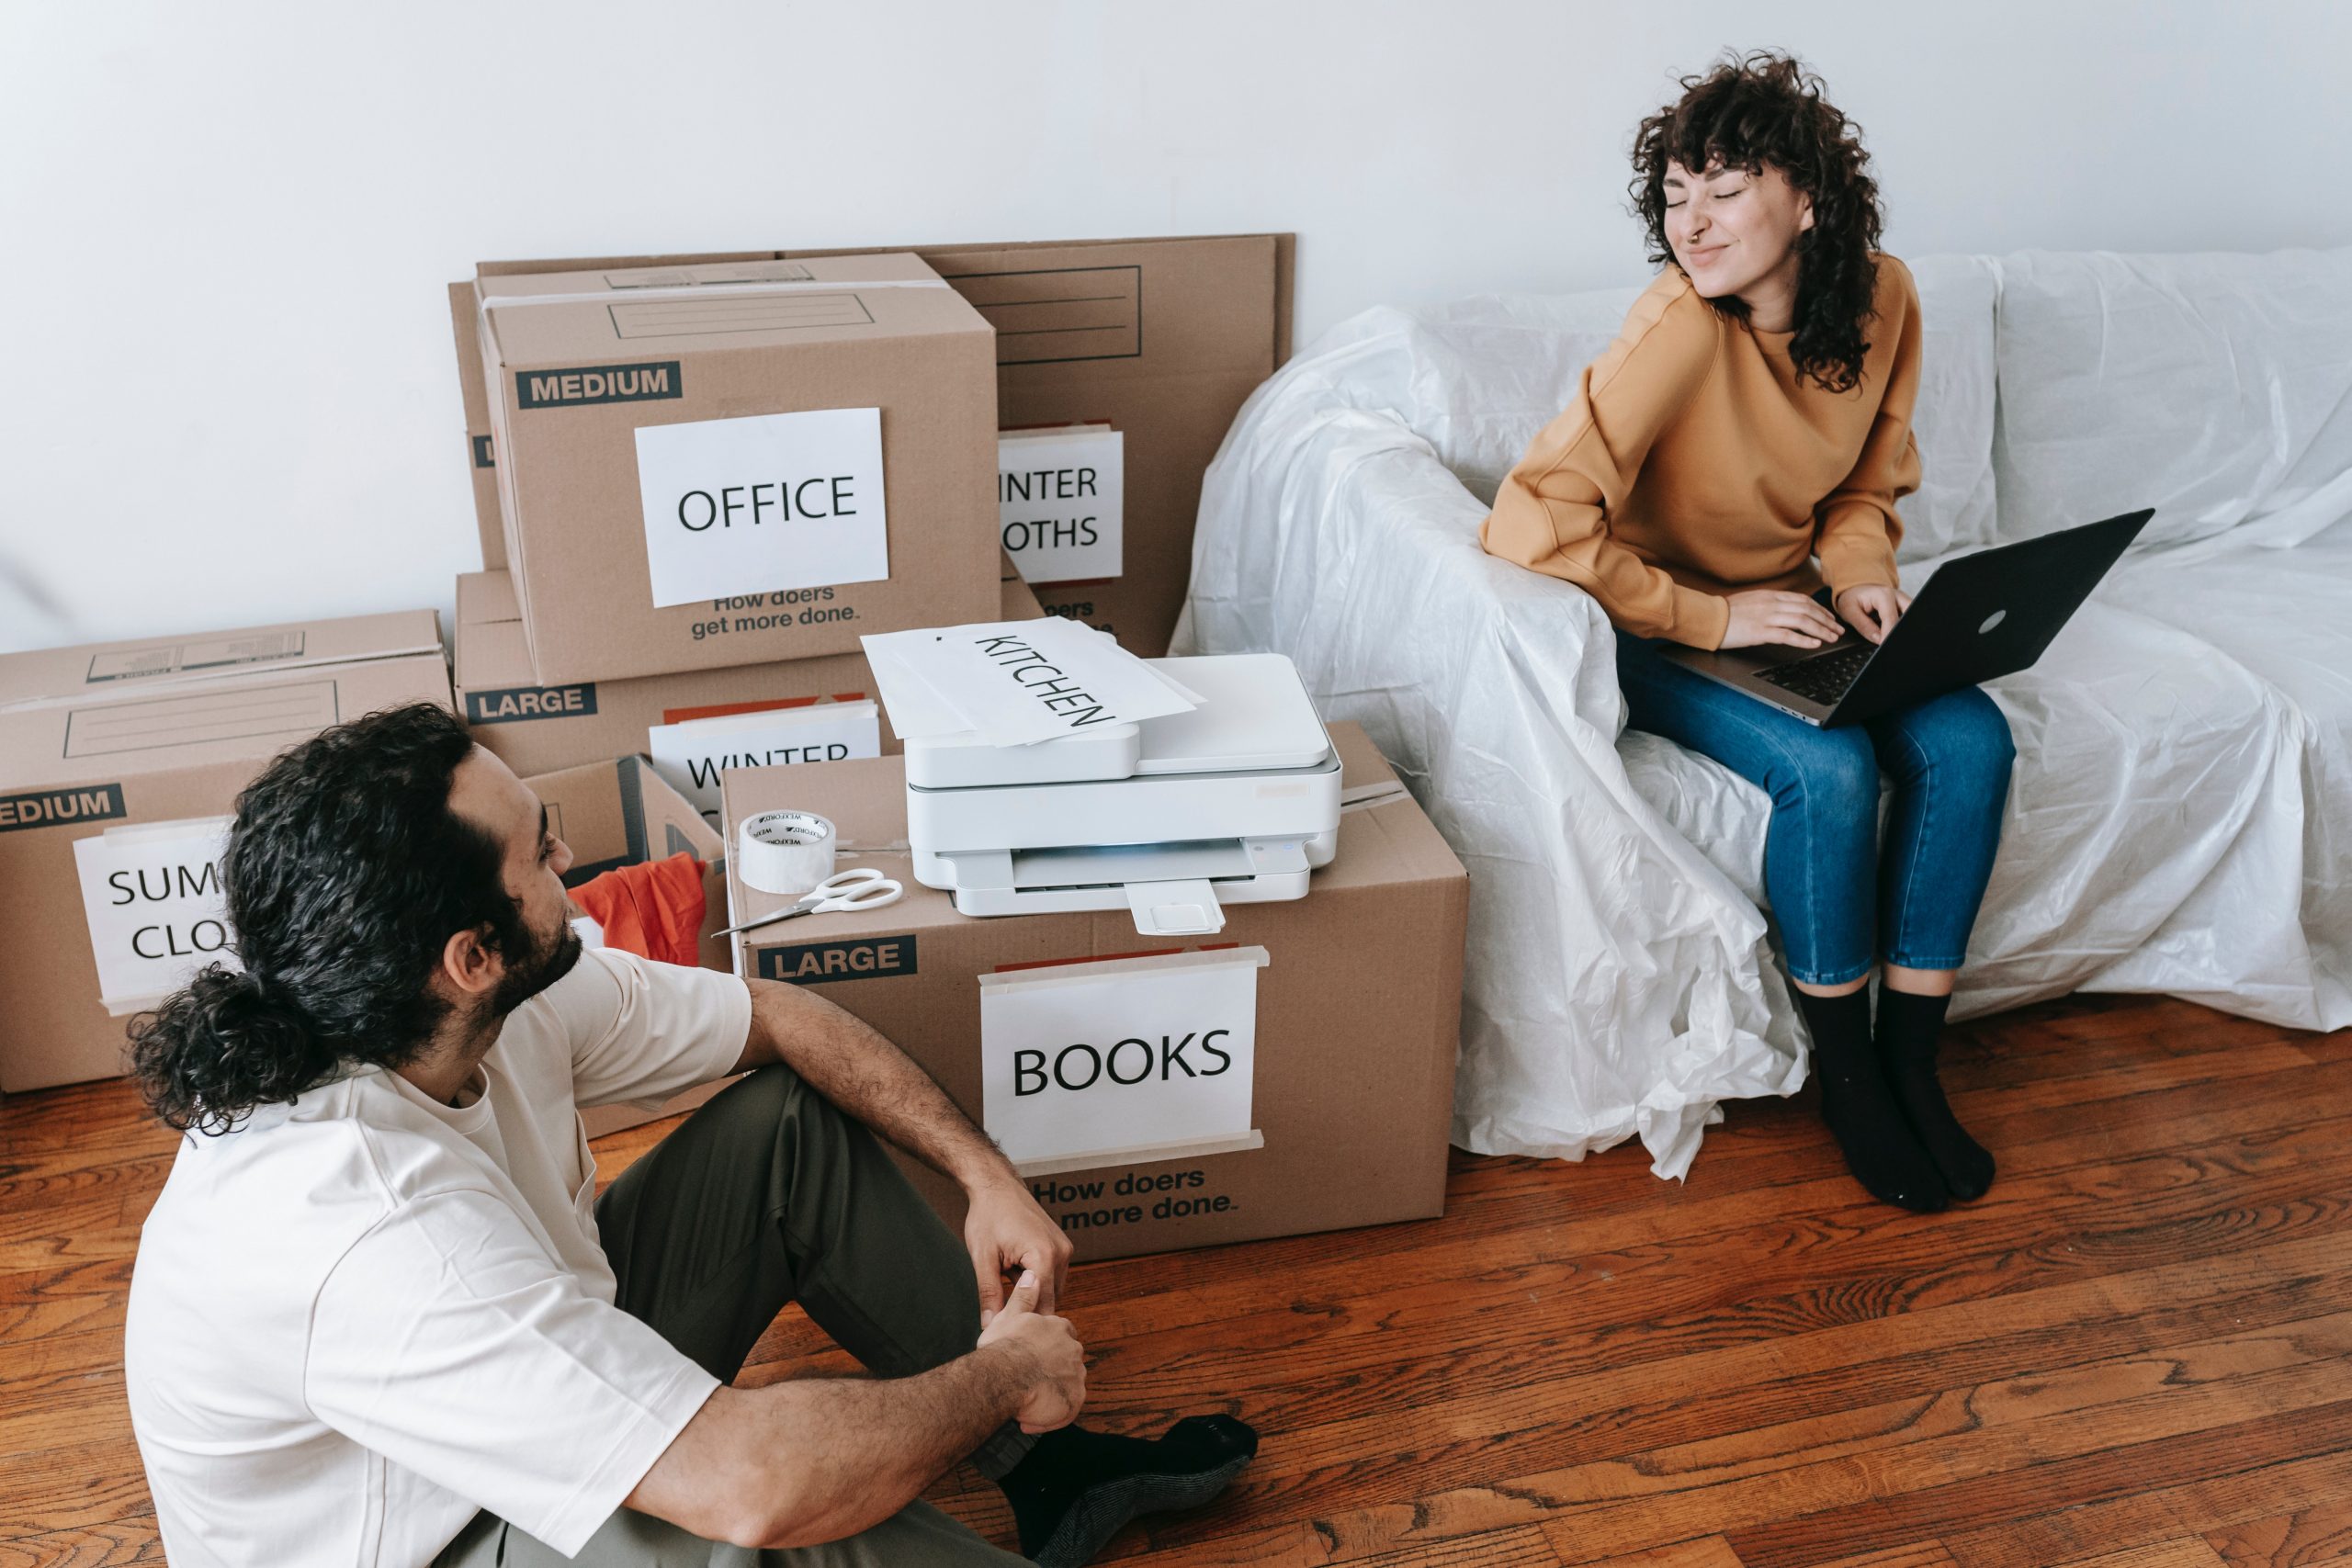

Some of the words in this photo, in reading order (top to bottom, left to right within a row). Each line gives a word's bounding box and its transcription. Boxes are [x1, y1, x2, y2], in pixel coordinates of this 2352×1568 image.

[530, 368, 669, 401] MEDIUM
[999, 468, 1097, 502] INTER
[678, 476, 857, 531] OFFICE
[1002, 516, 1098, 551] OTHS
[714, 593, 764, 612] How
[771, 587, 834, 605] doers
[692, 617, 729, 640] get
[735, 614, 793, 632] more
[975, 635, 1116, 728] KITCHEN
[479, 689, 583, 718] LARGE
[0, 790, 111, 825] EDIUM
[765, 813, 802, 821] WEXFORD
[108, 862, 220, 906] SUM
[131, 919, 227, 959] CLO
[775, 943, 900, 979] LARGE
[1013, 1029, 1231, 1097] BOOKS
[1033, 1181, 1105, 1204] How
[1114, 1169, 1205, 1196] doers
[1060, 1205, 1144, 1231] more
